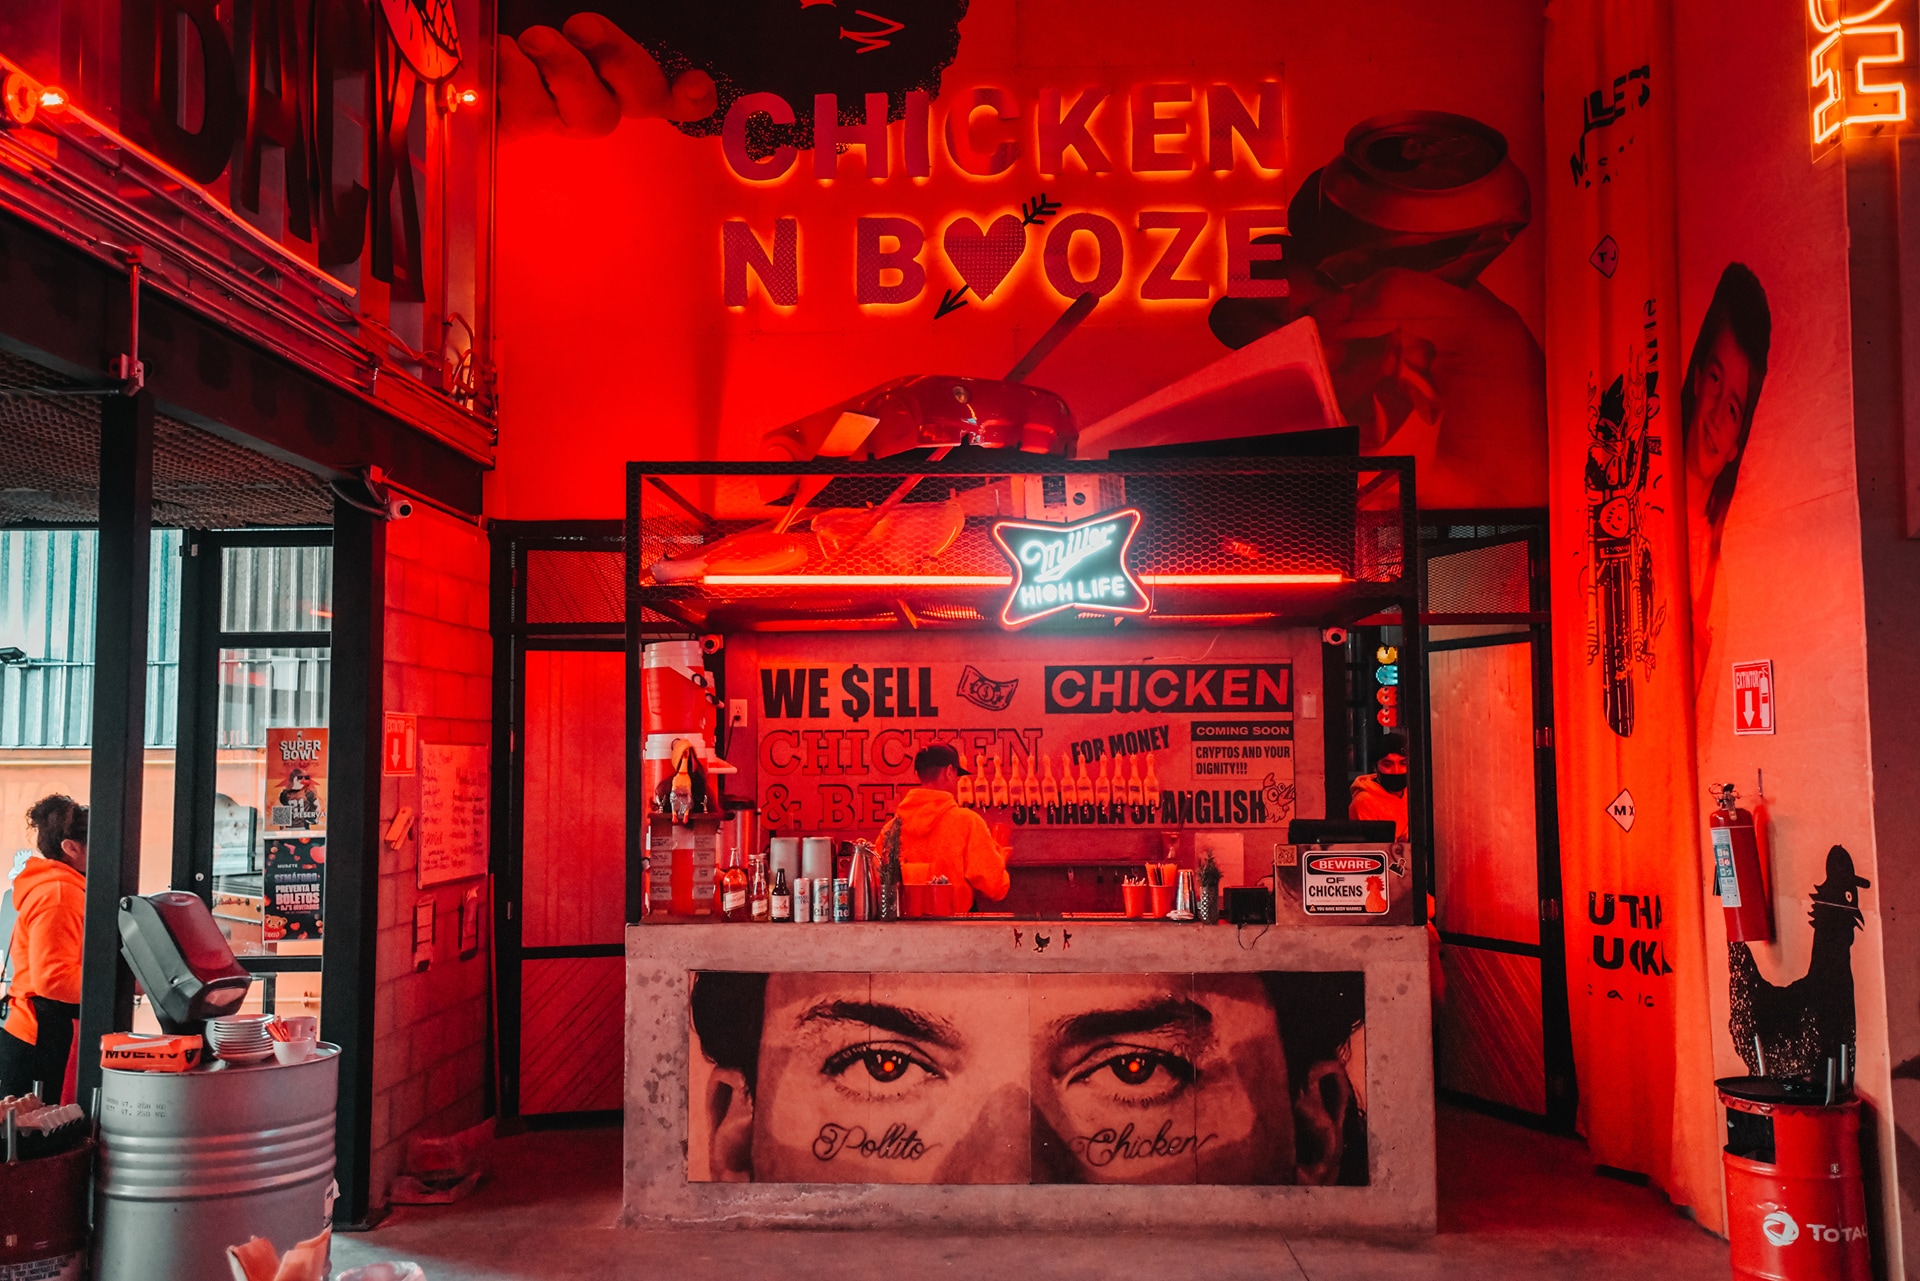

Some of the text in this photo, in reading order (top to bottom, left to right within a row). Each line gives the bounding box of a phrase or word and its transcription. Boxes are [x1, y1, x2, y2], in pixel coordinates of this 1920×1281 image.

[721, 80, 1286, 181] CHICKEN
[722, 218, 798, 307] N
[1020, 523, 1119, 583] Miller
[1020, 575, 1127, 609] HIGH LIFE
[760, 663, 938, 722] WE $ELL
[1051, 668, 1289, 708] CHICKEN
[1196, 725, 1290, 736] COMING SOON
[280, 740, 321, 751] SUPER
[282, 750, 319, 761] BOWL
[1071, 725, 1170, 766] FOR MONEY
[1195, 745, 1291, 759] CRYPTOS AND YOUR
[1196, 762, 1248, 775] DIGNITY!!!
[759, 783, 802, 830] &
[1319, 860, 1371, 870] BEWARE
[275, 883, 320, 893] PREVENTA DE
[275, 892, 320, 905] BOLETOS
[1308, 885, 1363, 897] CHICKENS
[813, 1119, 1218, 1167] Pollito Chicken
